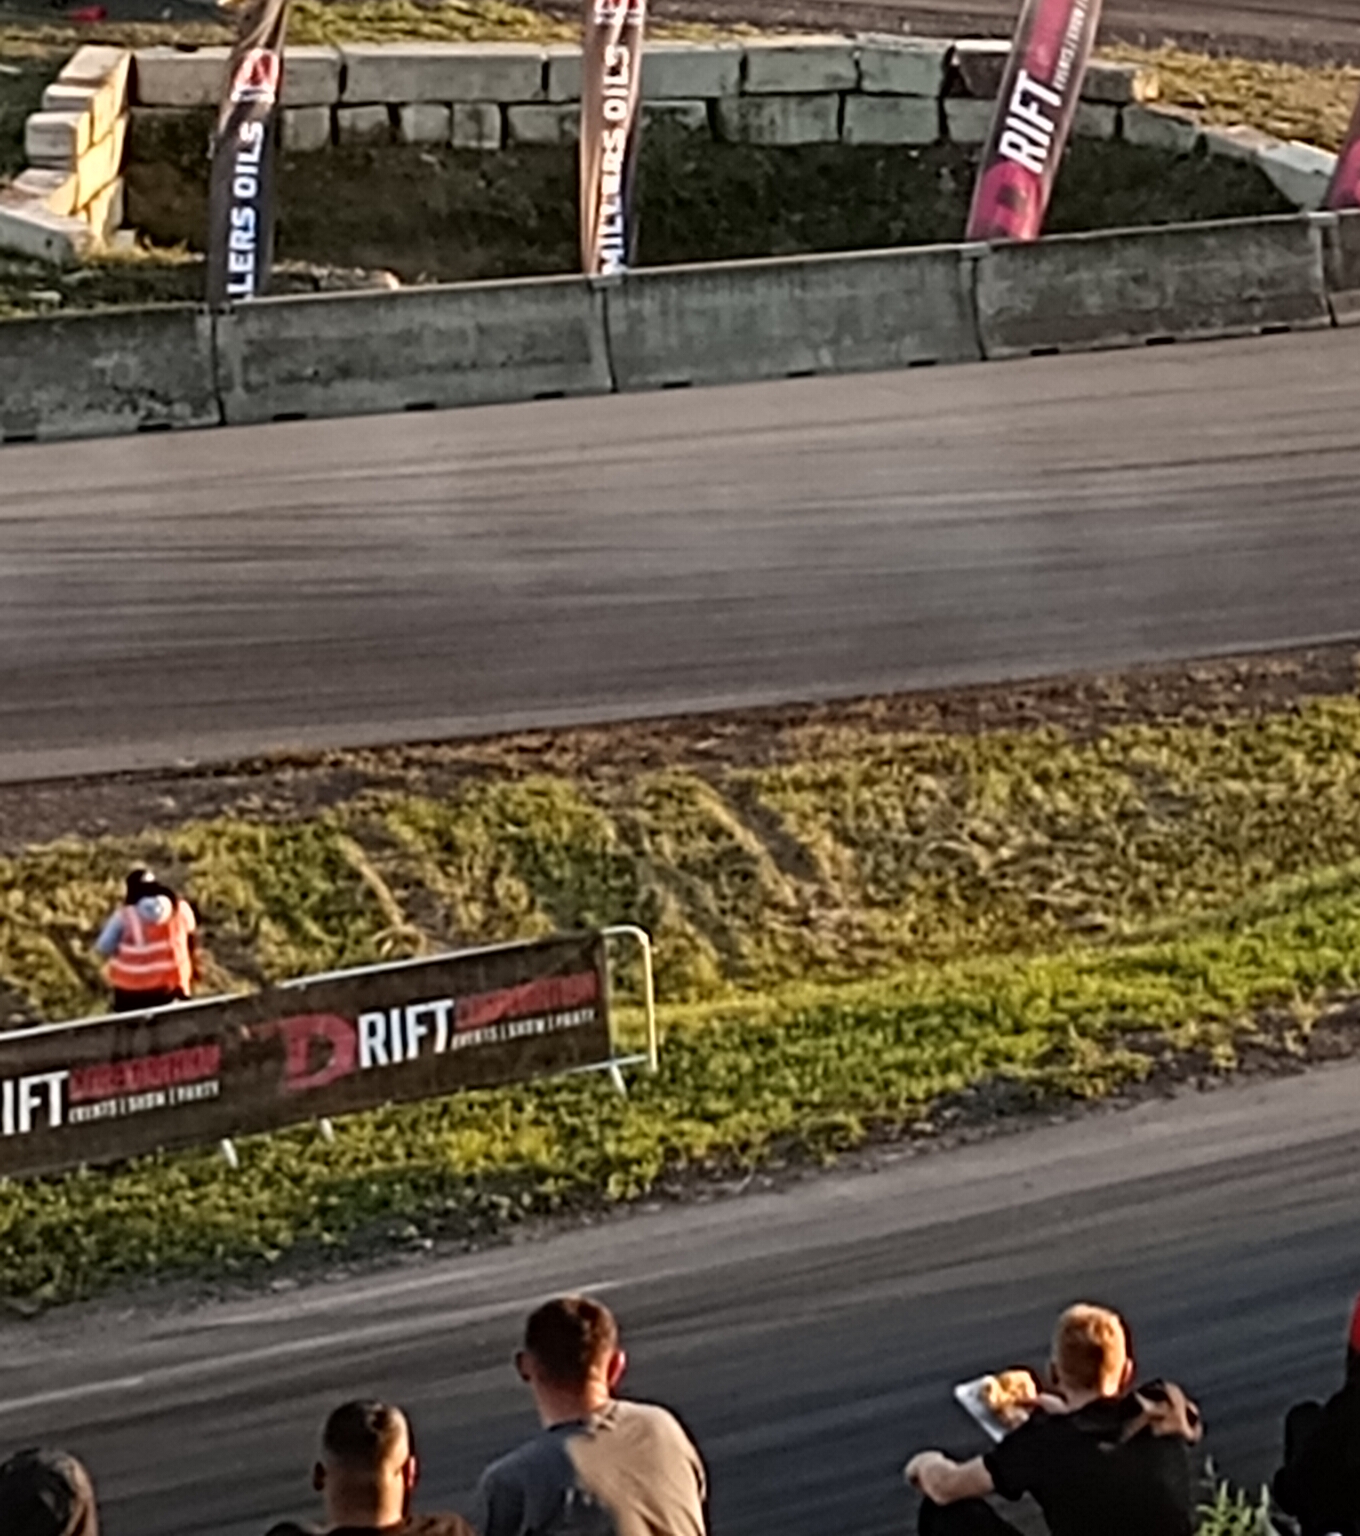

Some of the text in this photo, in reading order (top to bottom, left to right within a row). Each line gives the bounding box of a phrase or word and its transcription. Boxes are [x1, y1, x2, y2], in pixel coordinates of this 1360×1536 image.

[227, 121, 265, 302] LERS OILS
[598, 43, 631, 276] MILLERS OILS
[2, 1069, 69, 1135] IFT
